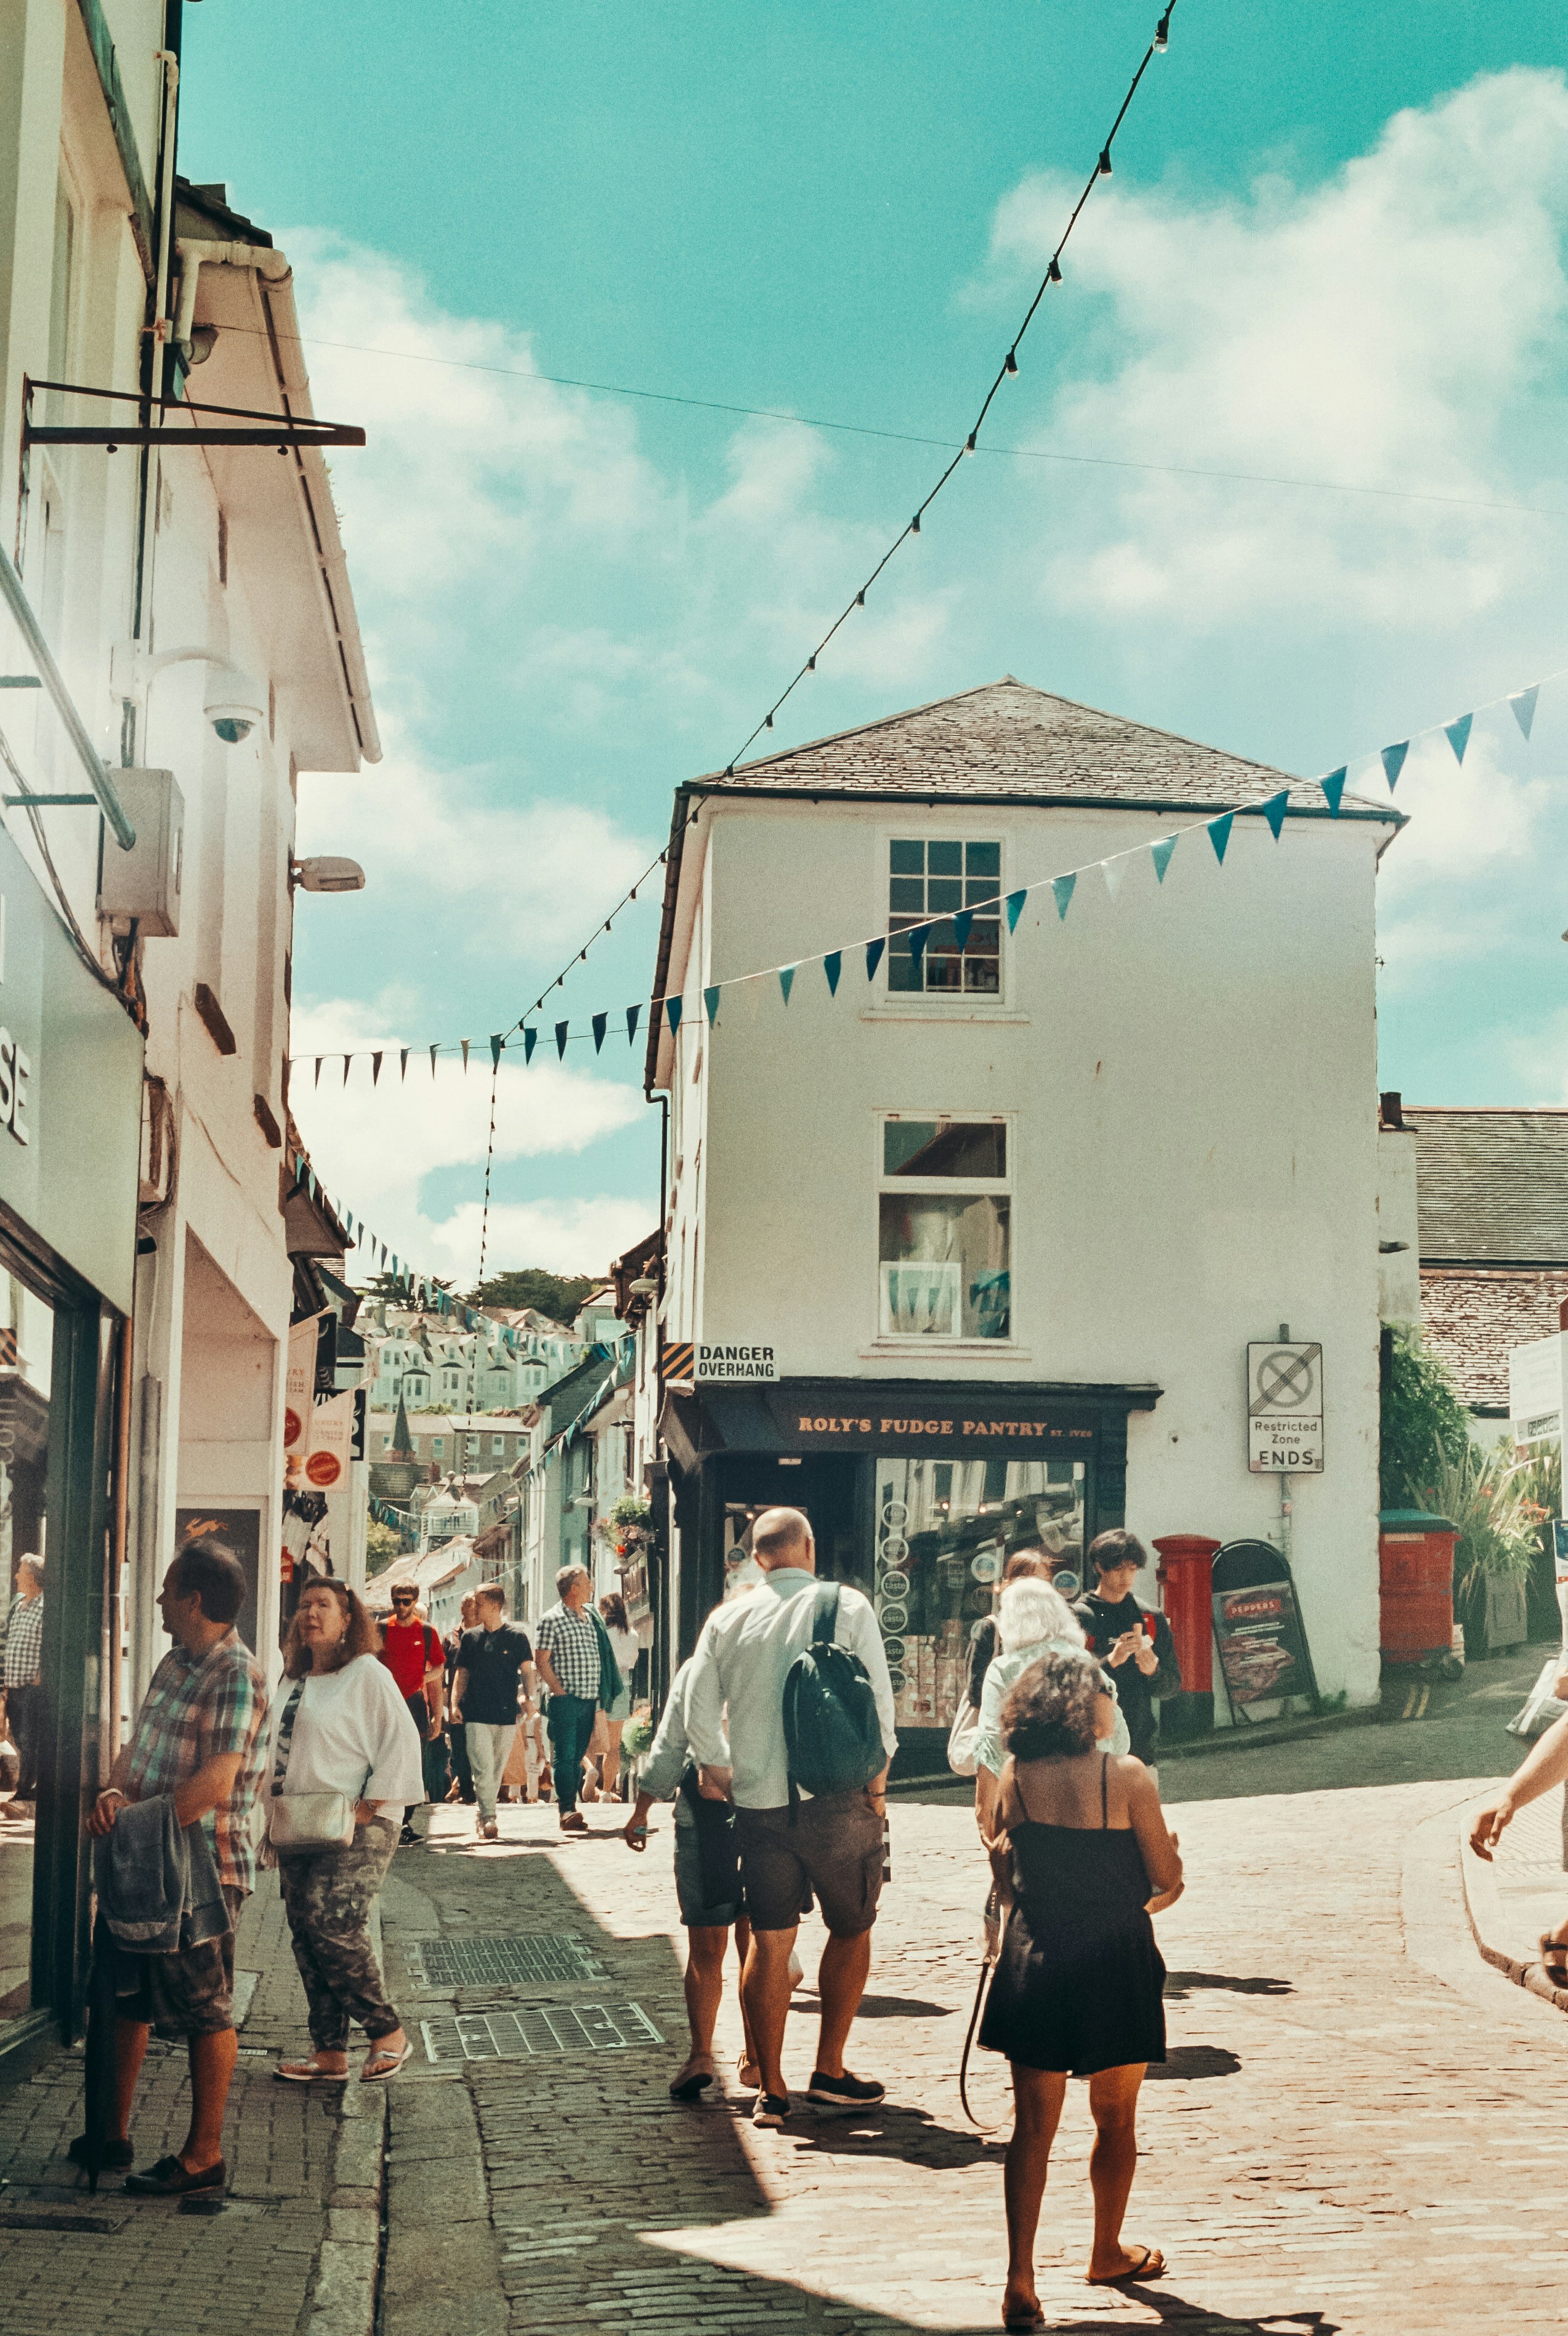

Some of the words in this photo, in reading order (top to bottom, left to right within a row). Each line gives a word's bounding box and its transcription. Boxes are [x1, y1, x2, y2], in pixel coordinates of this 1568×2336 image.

[700, 1346, 774, 1361] DANGER
[698, 1362, 774, 1377] OVERHANG
[798, 1417, 872, 1433] ROLY'S
[880, 1419, 953, 1434] FUDGE
[963, 1421, 1047, 1436] PANTRY
[1255, 1421, 1317, 1432] Restricted
[1272, 1434, 1301, 1444] Zone
[1259, 1451, 1313, 1465] ENDS
[1231, 1601, 1275, 1615] PEPPERS
